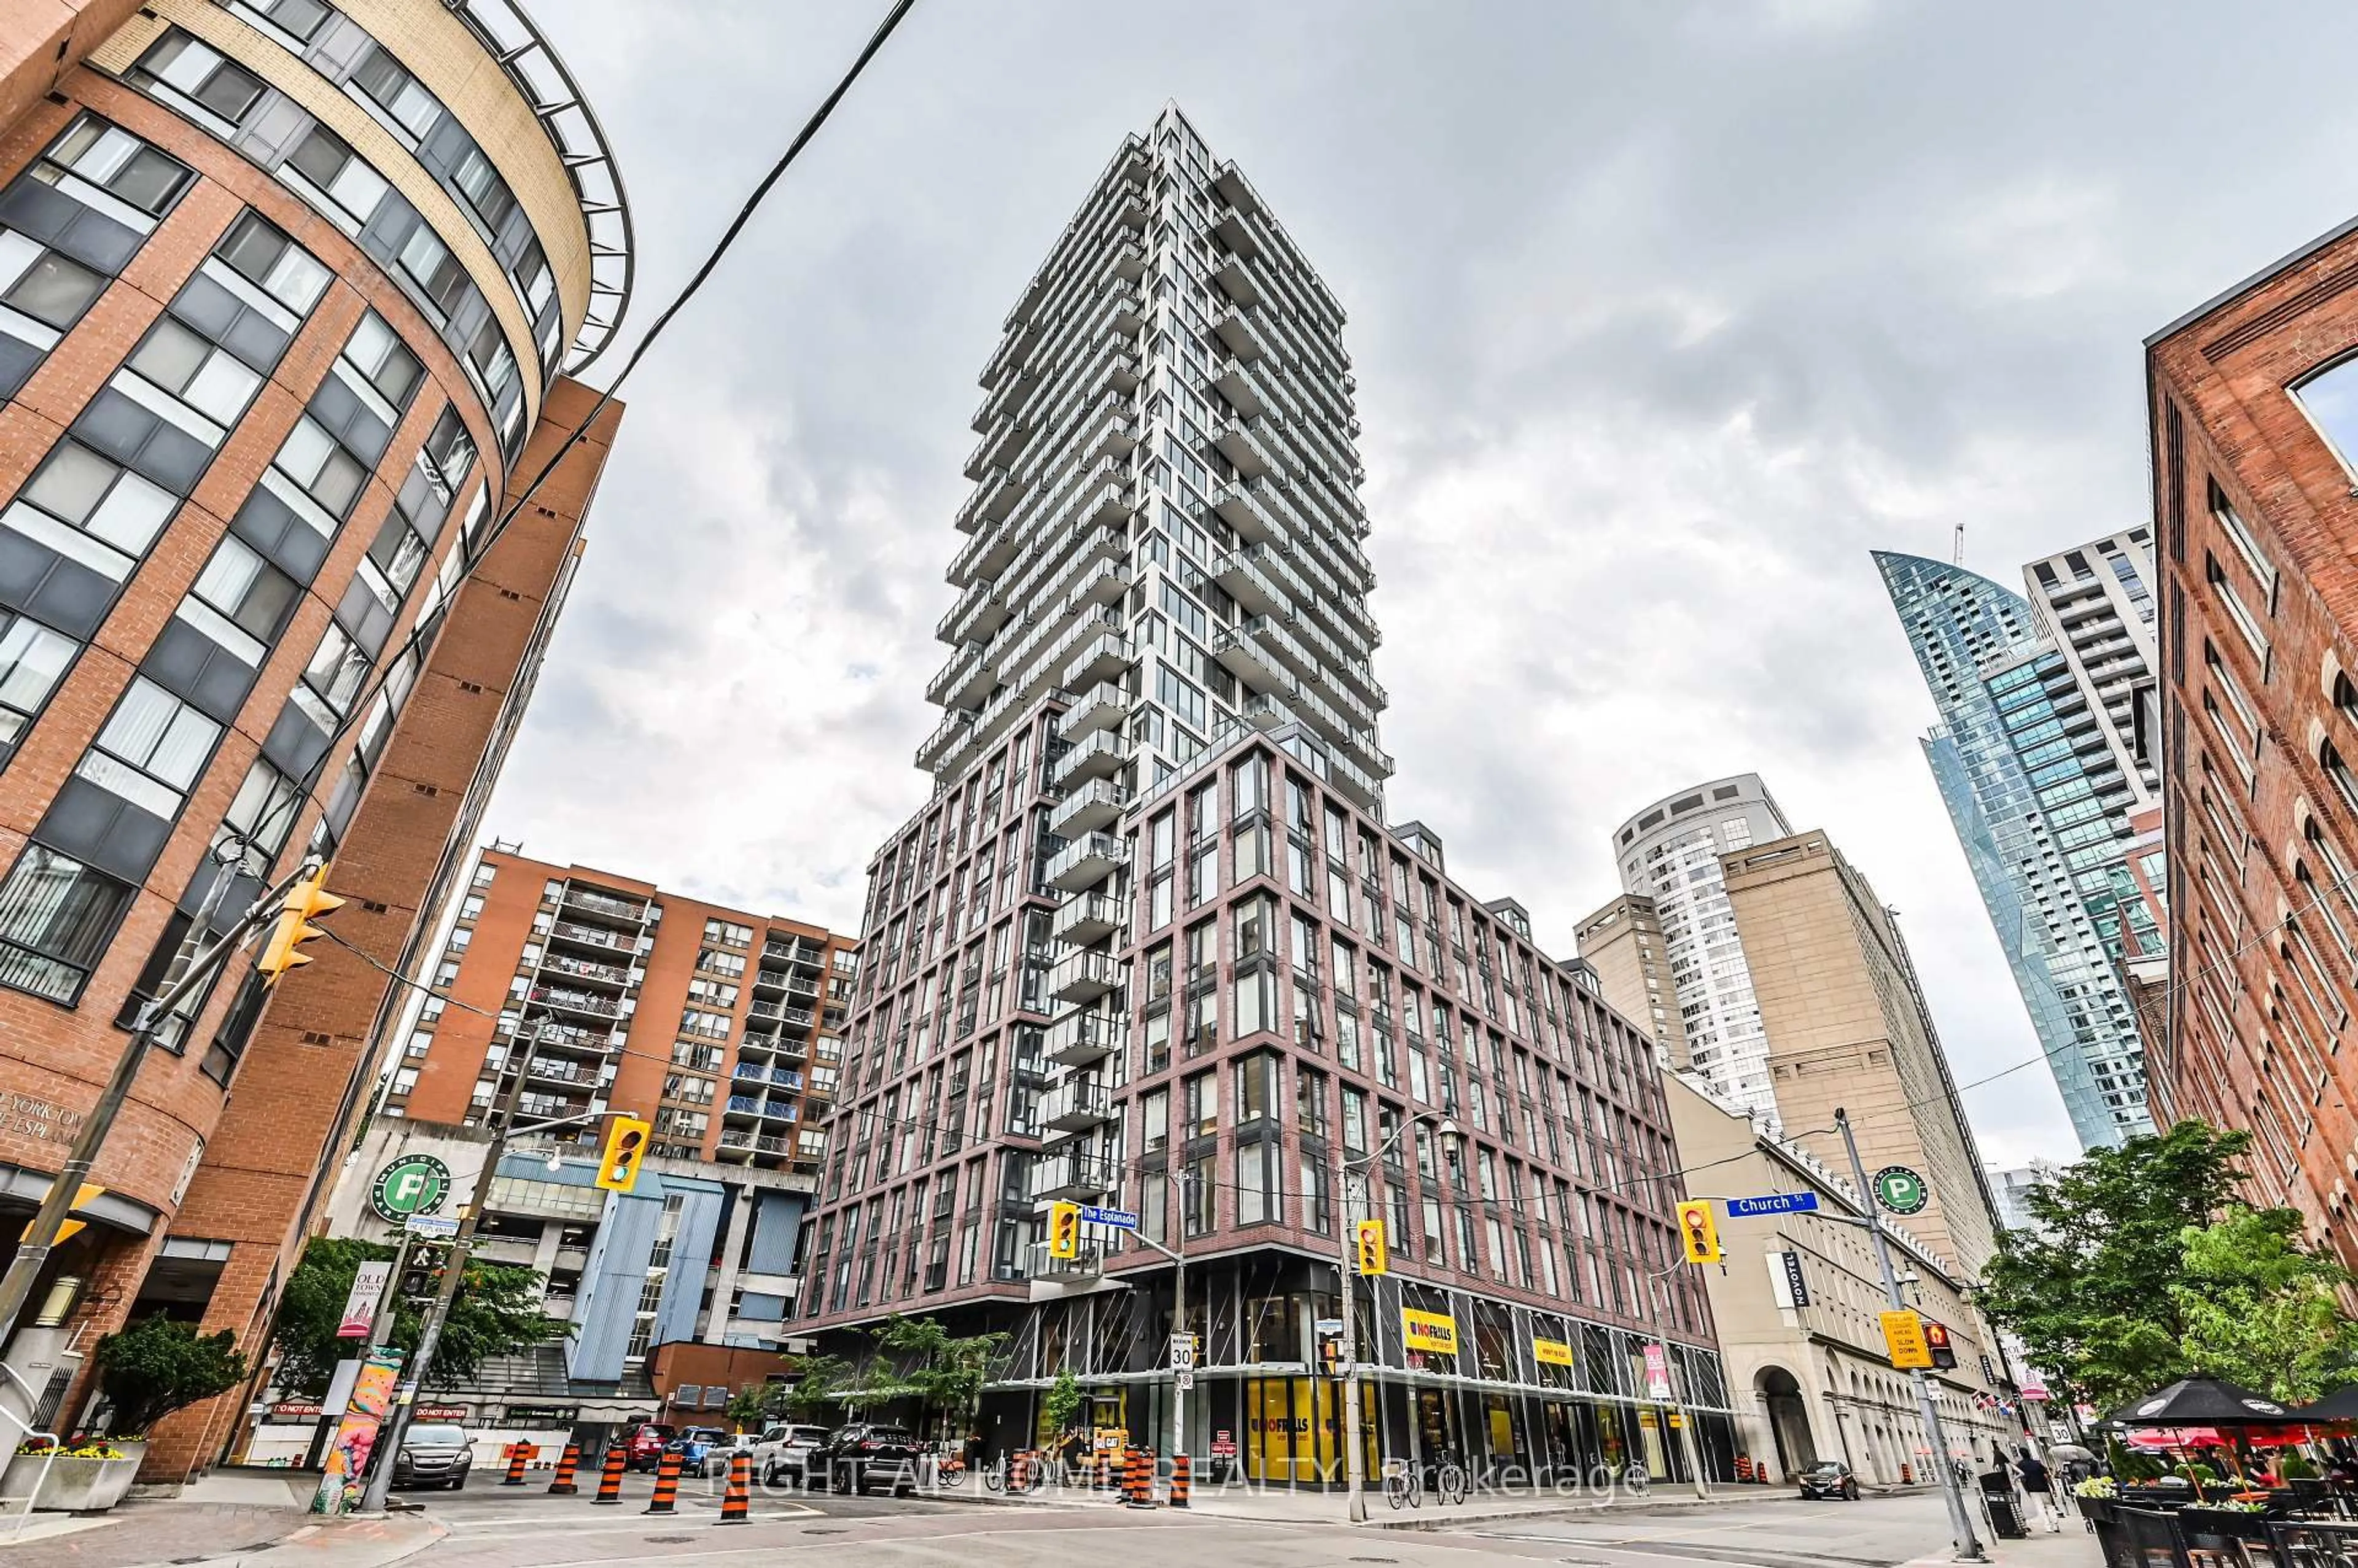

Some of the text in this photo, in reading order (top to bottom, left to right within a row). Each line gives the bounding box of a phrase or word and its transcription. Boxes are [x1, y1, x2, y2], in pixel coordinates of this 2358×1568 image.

[11, 1095, 54, 1120] YORK
[56, 1109, 85, 1133] TOW
[378, 1156, 449, 1189] MUNICIPAL
[395, 1173, 429, 1200] P
[1888, 1179, 1910, 1198] P
[375, 1190, 442, 1219] PARKNG
[1739, 1197, 1790, 1212] Church
[1084, 1206, 1135, 1225] The Esplanade
[357, 1274, 385, 1284] OLD
[1786, 1254, 1805, 1305] NOVOTEL
[1173, 1349, 1191, 1365] 30
[443, 1408, 466, 1417] ENTER
[1106, 1437, 1118, 1448] CAT
[2055, 1429, 2069, 1439] 30
